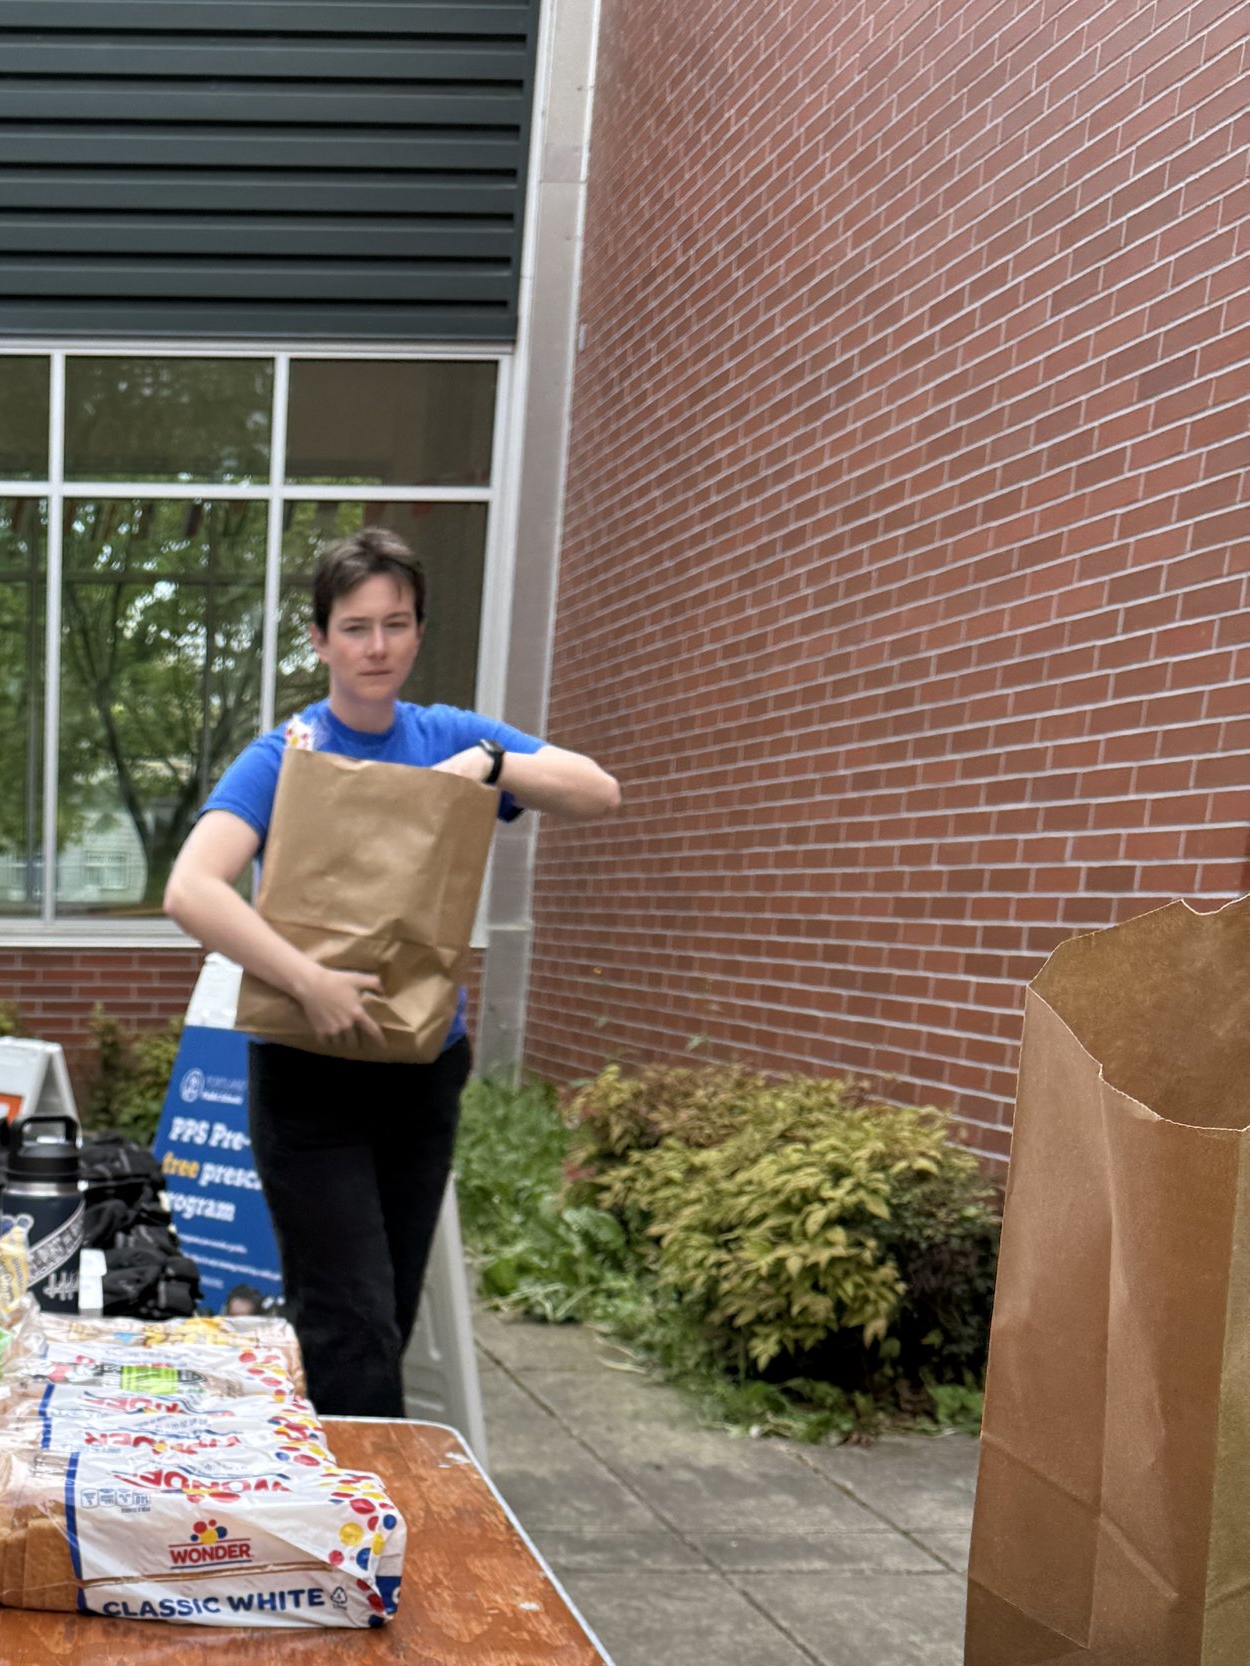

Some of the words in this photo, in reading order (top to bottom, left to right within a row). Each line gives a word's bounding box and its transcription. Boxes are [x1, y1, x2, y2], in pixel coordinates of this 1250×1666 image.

[169, 1117, 211, 1146] PPS
[161, 1152, 200, 1179] free
[170, 1544, 251, 1565] WONDER
[103, 1597, 221, 1617] CLASSIC
[227, 1588, 325, 1611] WHITE
